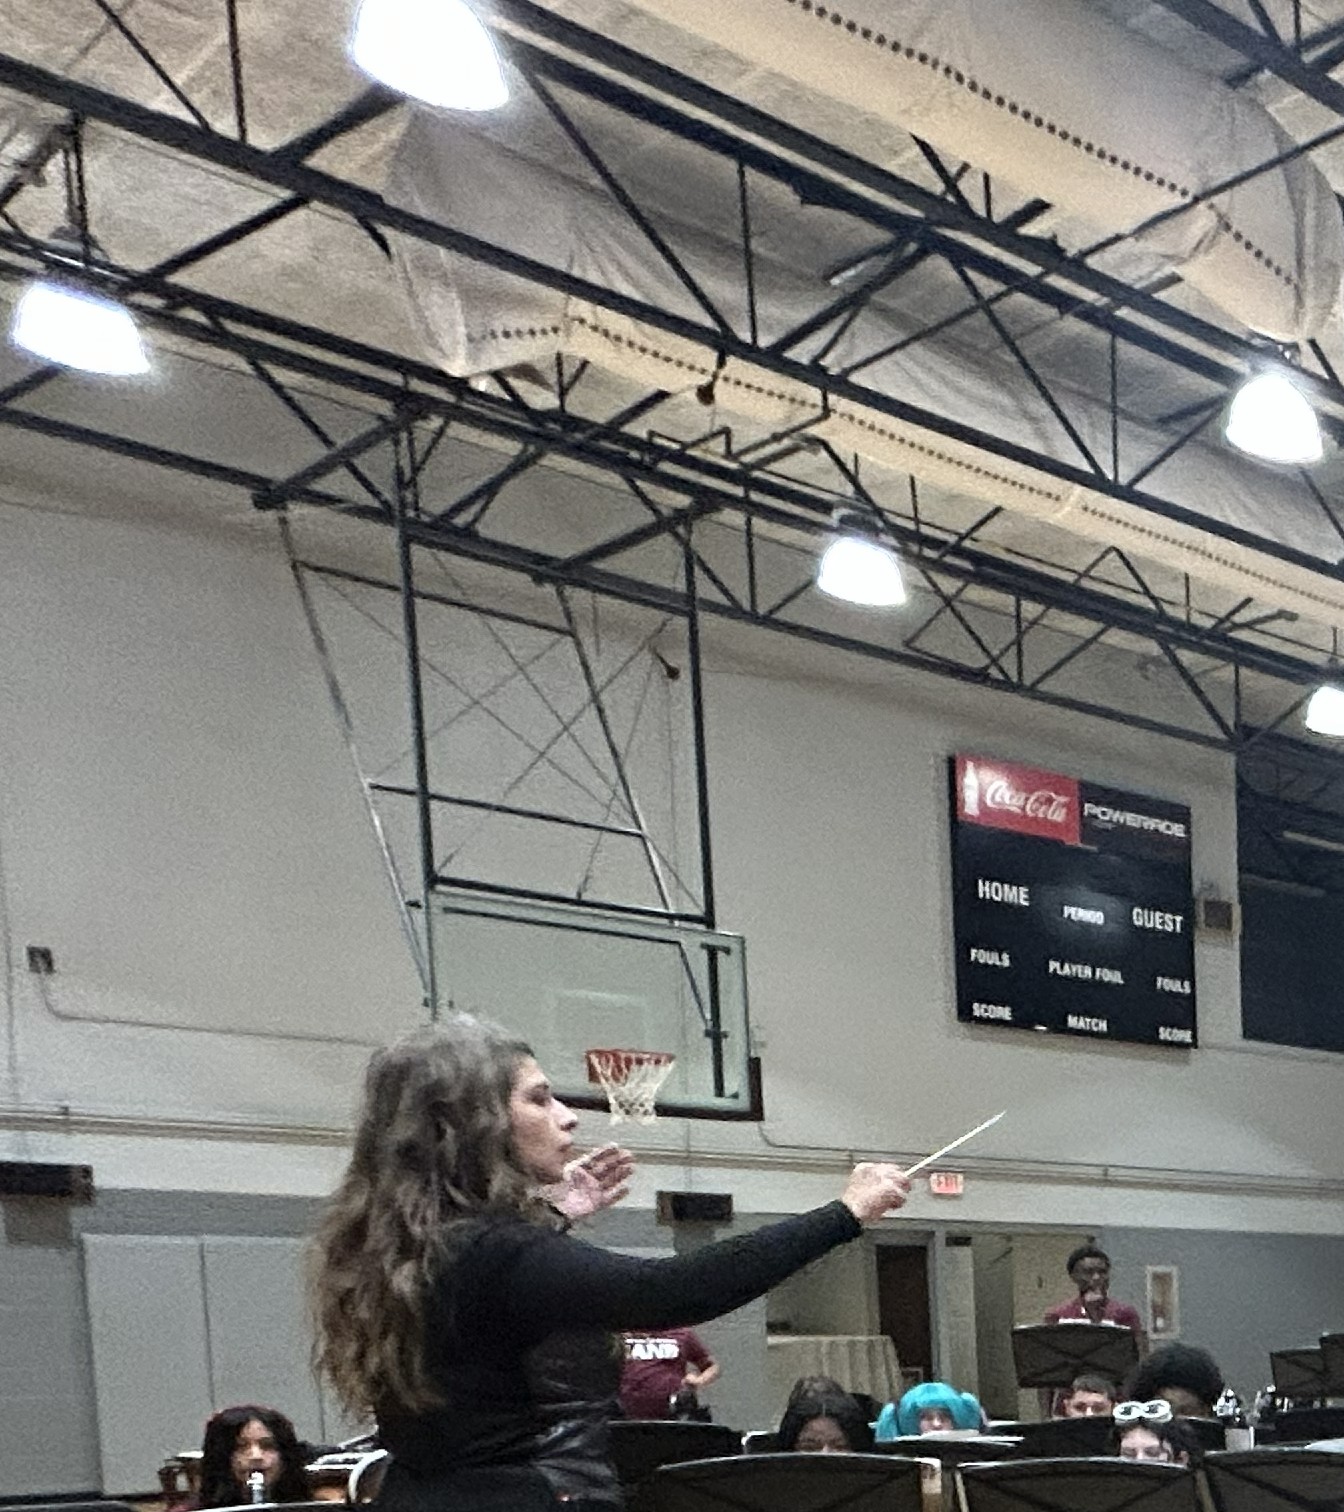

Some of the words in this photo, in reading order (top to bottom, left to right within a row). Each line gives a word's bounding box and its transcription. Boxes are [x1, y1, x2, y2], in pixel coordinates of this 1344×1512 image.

[1083, 801, 1187, 838] POWERADE
[977, 878, 1030, 906] HOME
[1062, 905, 1105, 925] PERIOD
[1132, 906, 1184, 933] GUEST
[970, 948, 1011, 968] FOULS
[1048, 959, 1092, 980] PLAYER
[1095, 966, 1125, 985] FOUL
[1156, 975, 1191, 995] FOULS
[972, 1002, 1013, 1022] SCORE
[1066, 1014, 1108, 1033] MATCH
[1158, 1026, 1193, 1044] SCORE
